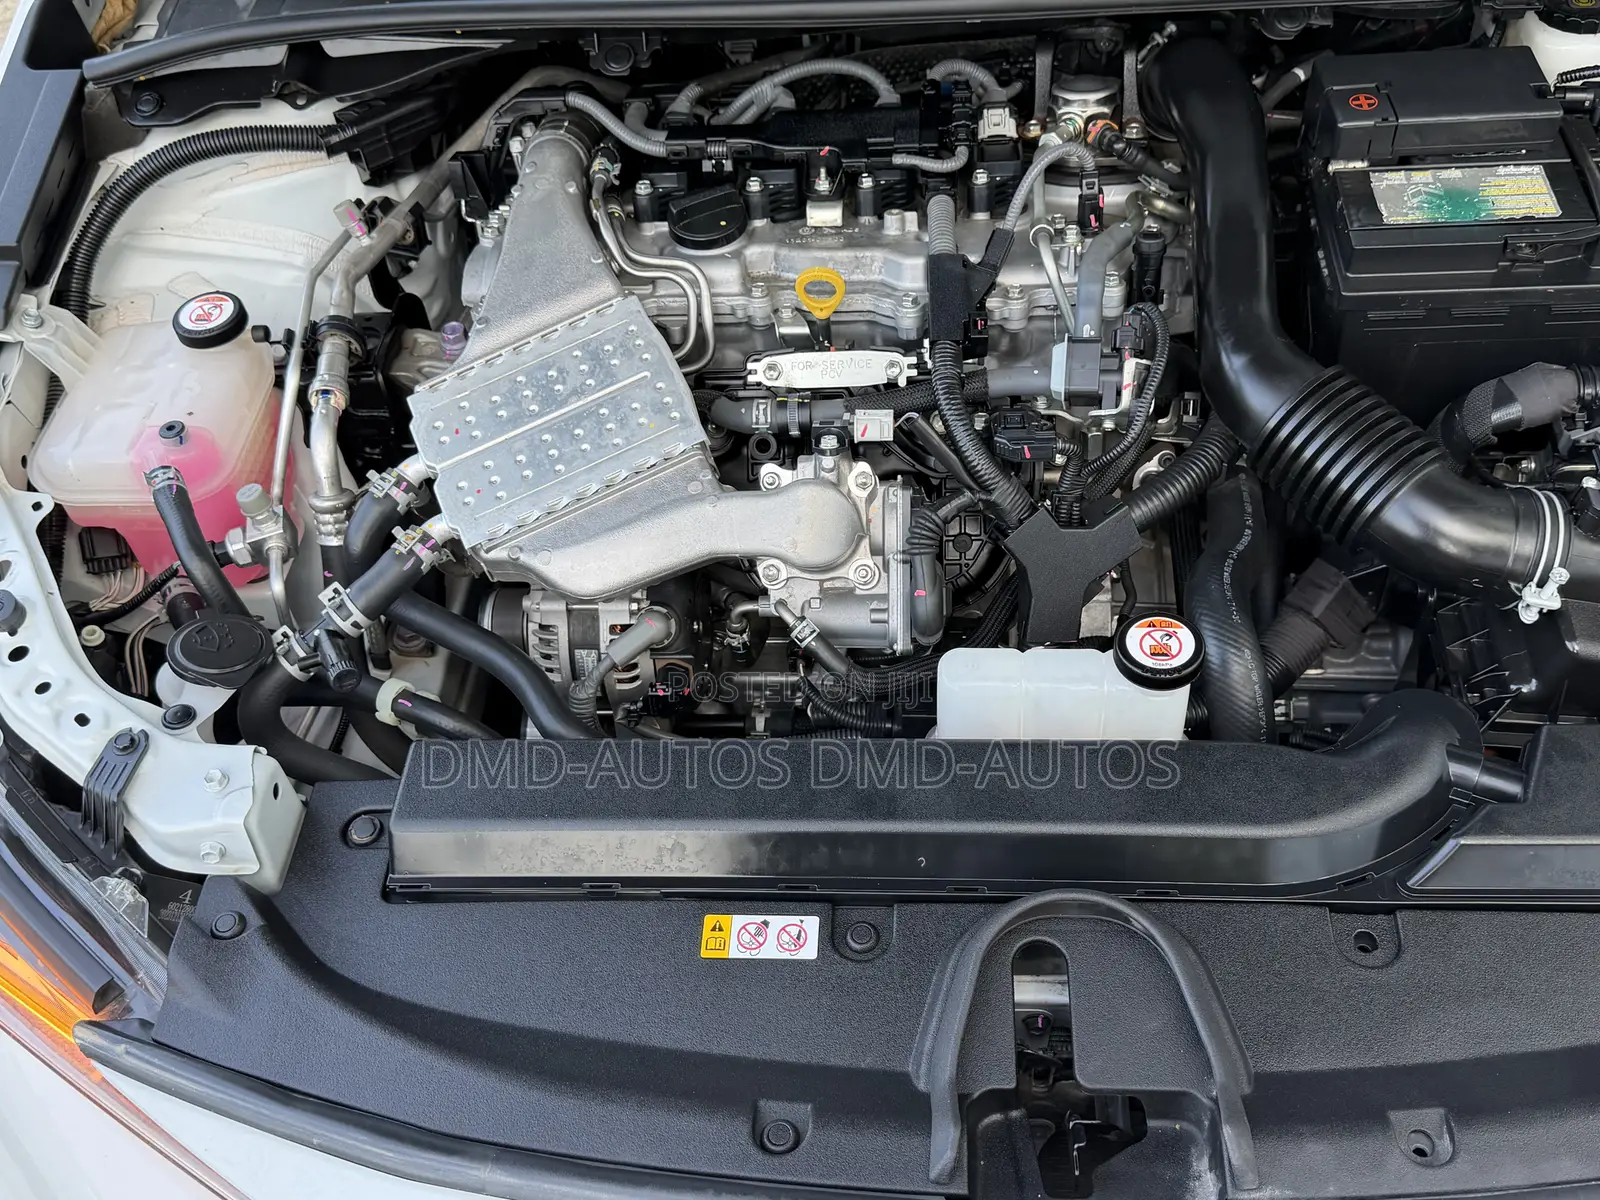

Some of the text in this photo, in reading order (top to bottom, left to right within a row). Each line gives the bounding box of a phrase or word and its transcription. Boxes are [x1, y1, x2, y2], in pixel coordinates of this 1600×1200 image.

[791, 358, 873, 371] FOR SERVICE
[820, 369, 843, 379] PCV
[179, 889, 192, 903] 4
